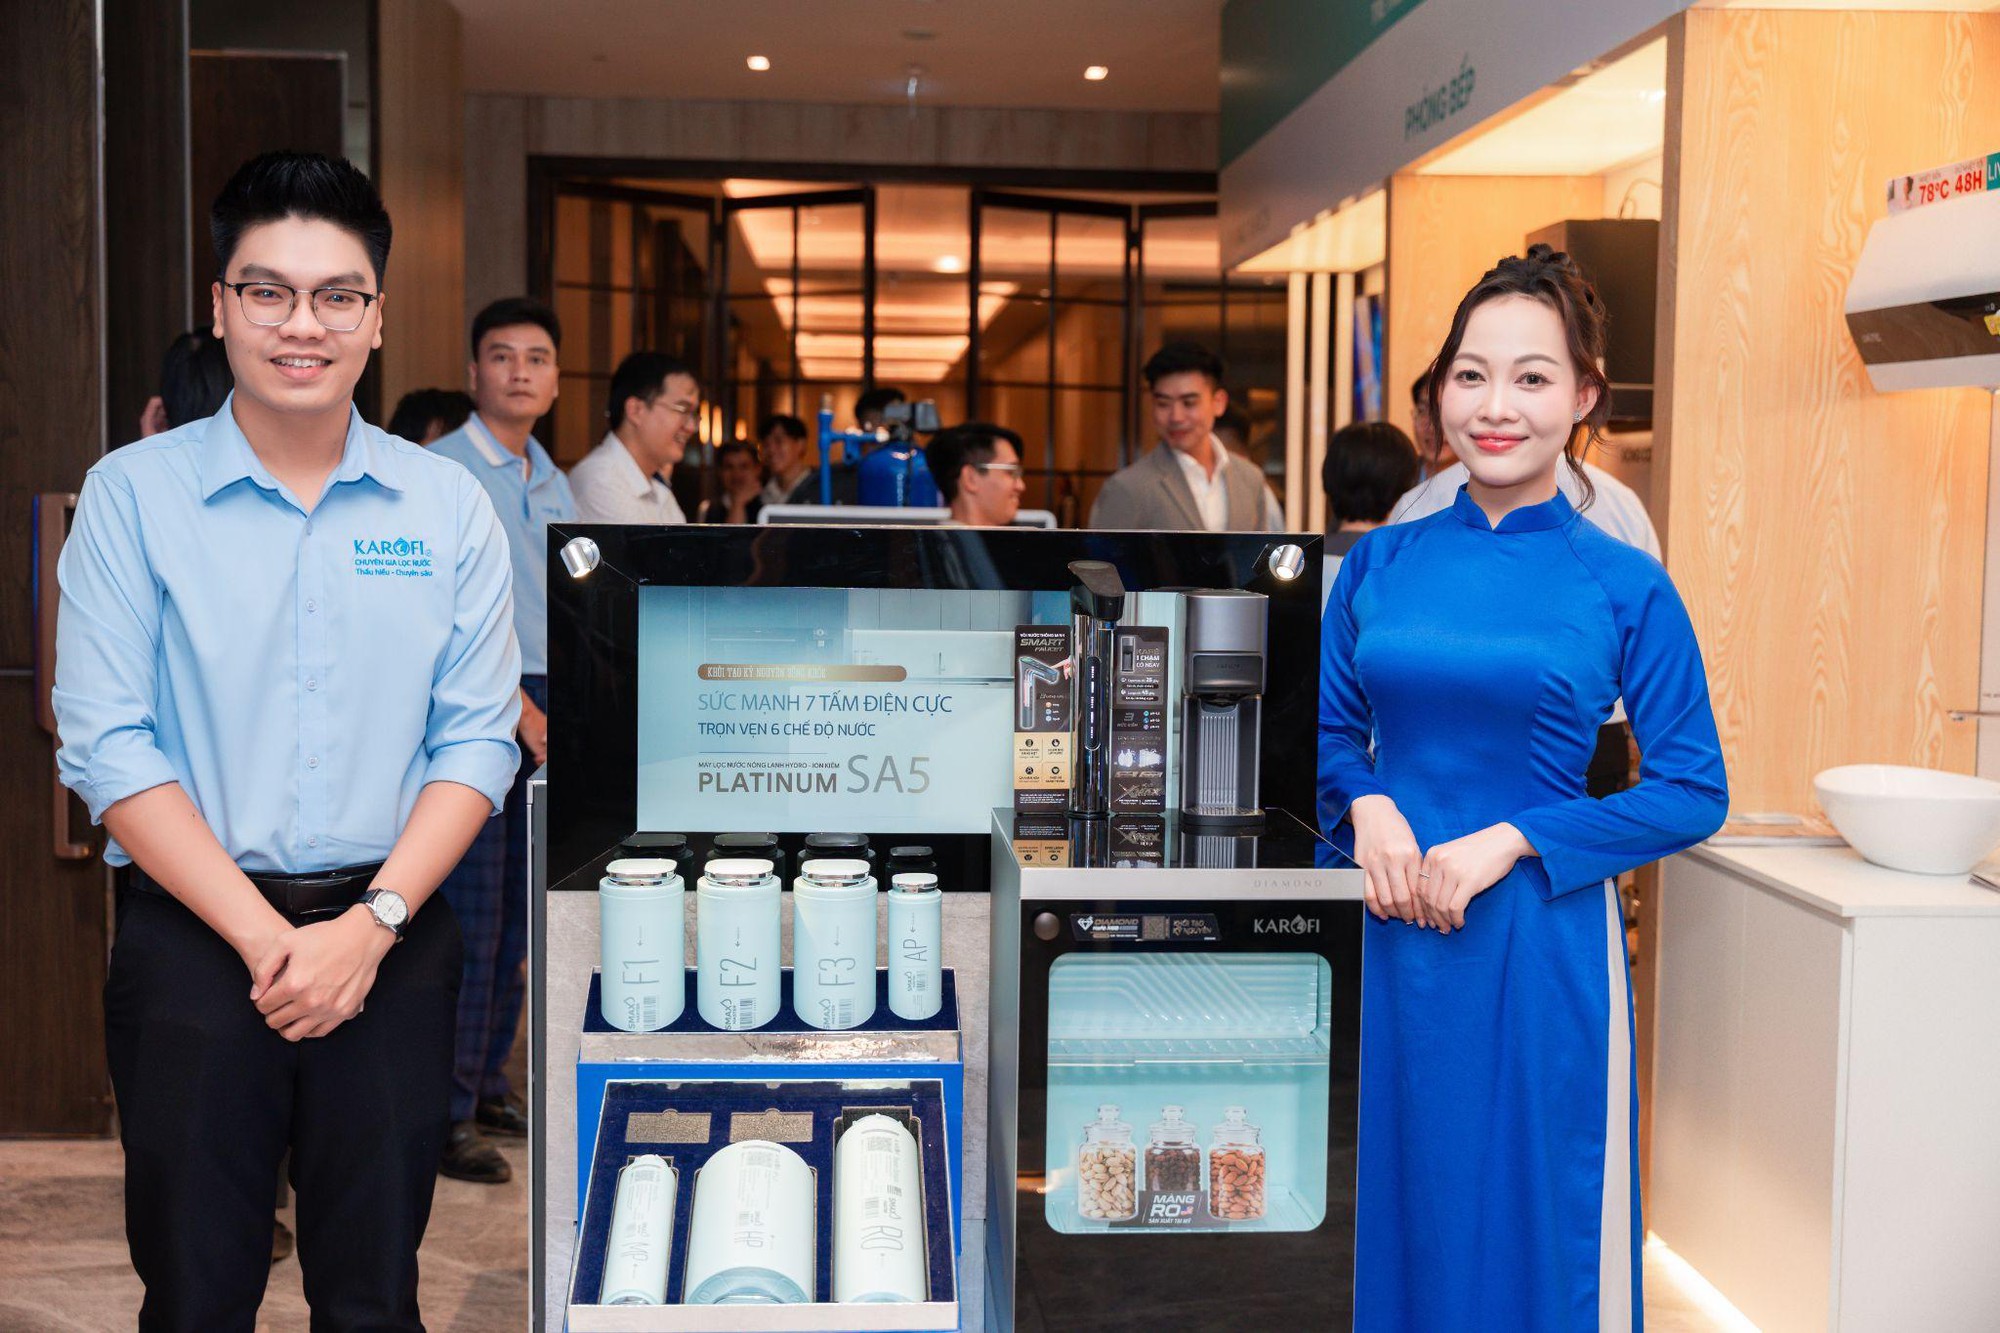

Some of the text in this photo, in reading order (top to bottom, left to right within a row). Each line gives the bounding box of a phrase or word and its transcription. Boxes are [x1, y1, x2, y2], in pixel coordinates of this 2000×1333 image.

[1955, 169, 1982, 193] 48H
[354, 537, 424, 557] KAROFI
[1020, 638, 1065, 647] SMART
[698, 690, 952, 716] SỨC MẠNH 7 TẤM ĐIỆN CỰC
[698, 720, 876, 739] TRỌN VẸN 6 CHẾ ĐỘ NƯỚC
[699, 754, 930, 794] PLATINUM SA5
[1254, 880, 1323, 888] DIAMOND
[1254, 914, 1320, 934] KAROFI
[903, 939, 927, 962] AP
[623, 960, 660, 984] F1
[720, 957, 757, 986] F2
[818, 957, 856, 986] F3
[1150, 1203, 1181, 1217] RO
[861, 1225, 904, 1251] RO
